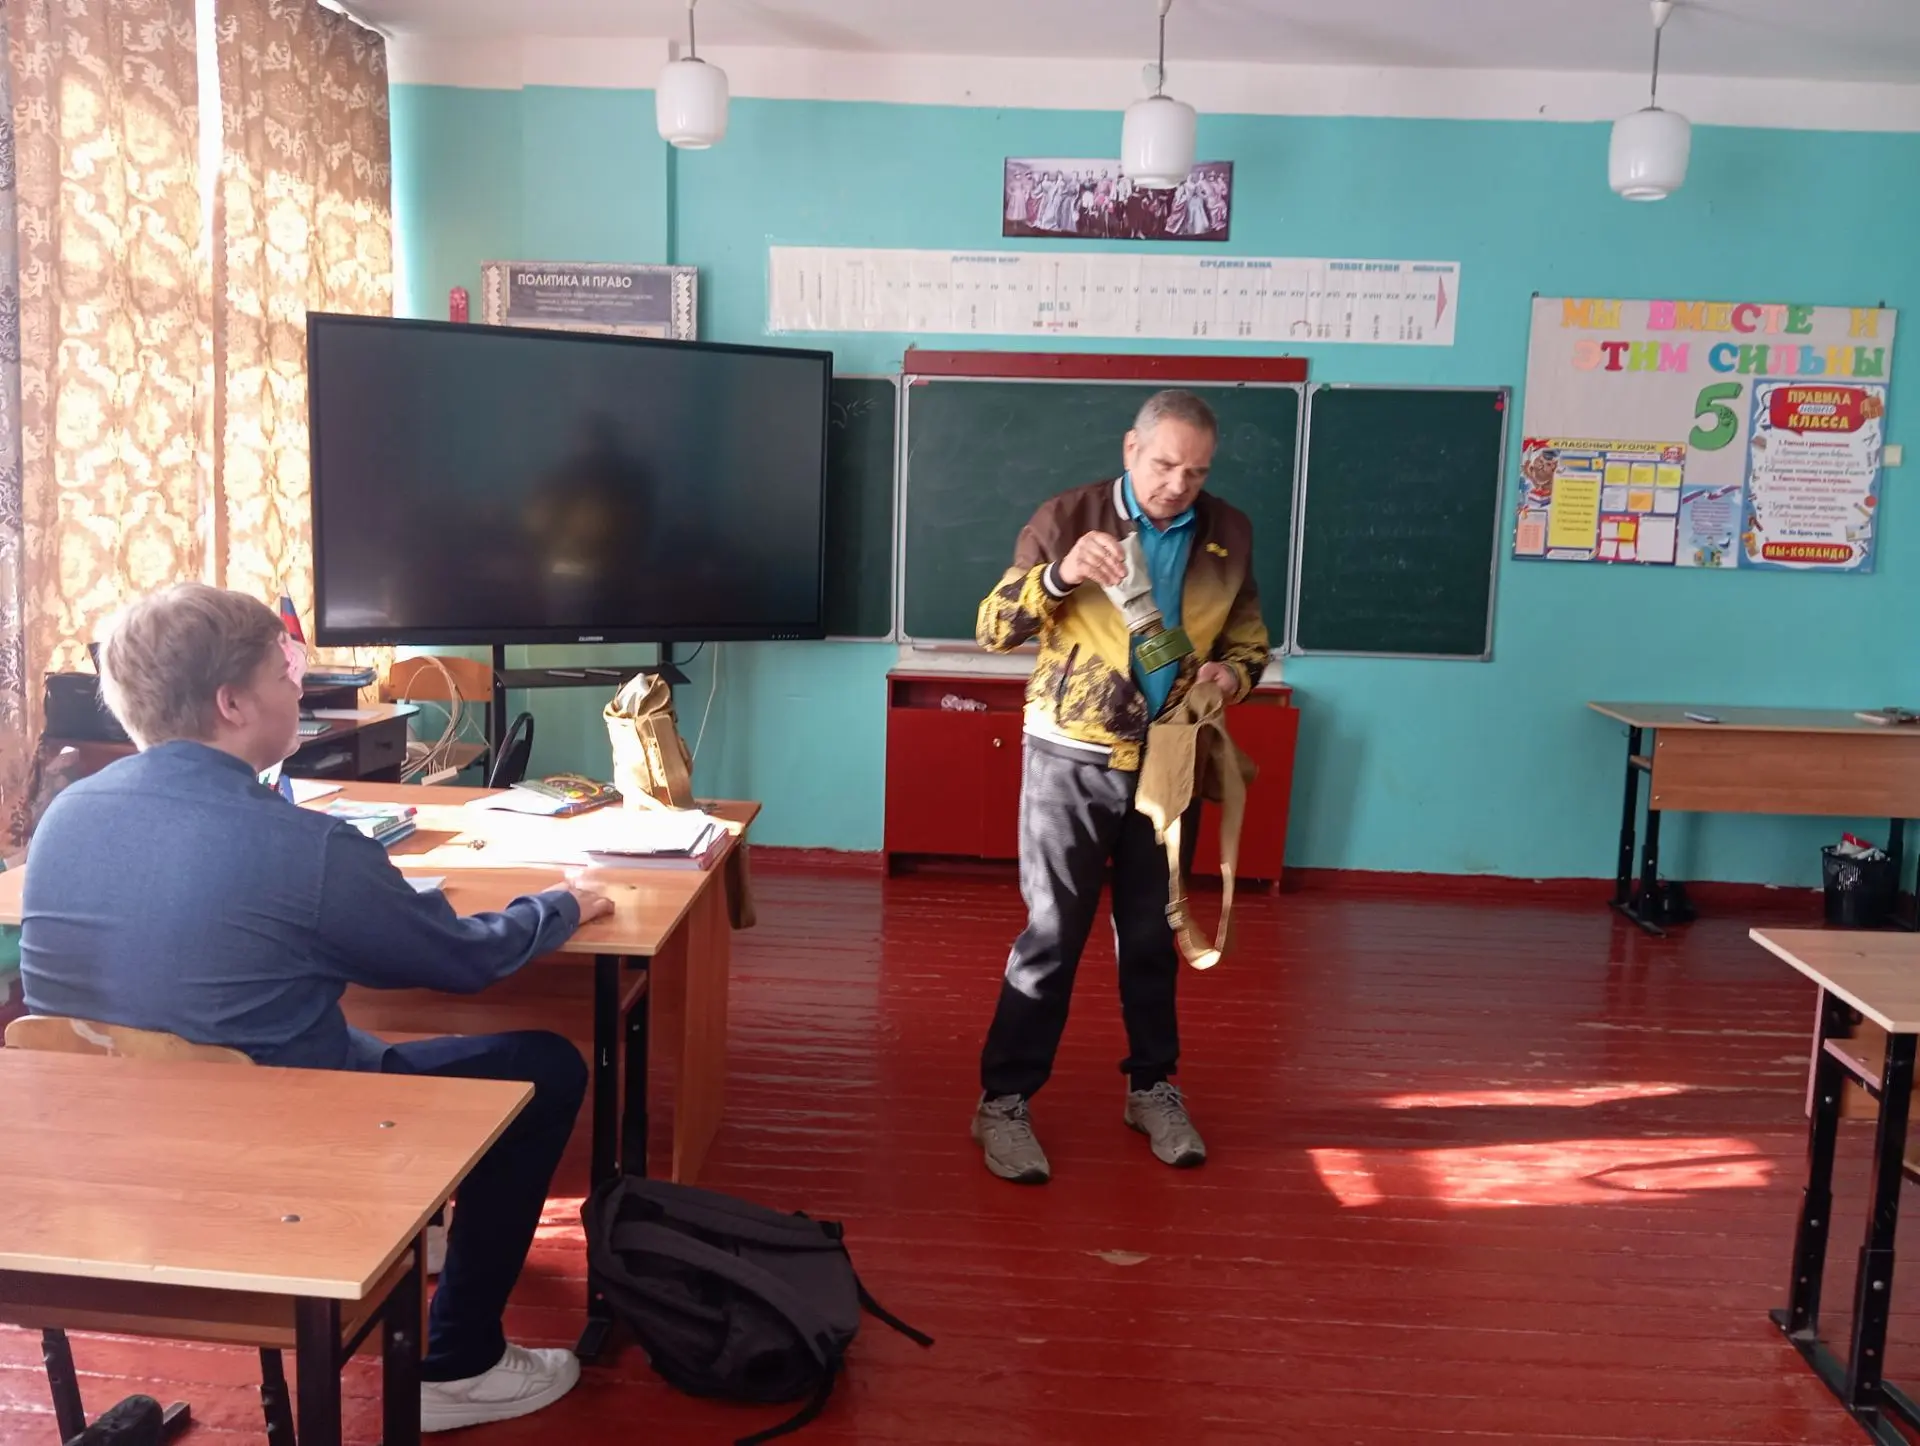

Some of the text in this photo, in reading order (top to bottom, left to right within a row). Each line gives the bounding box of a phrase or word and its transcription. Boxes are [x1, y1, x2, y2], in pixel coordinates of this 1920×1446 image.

[518, 274, 632, 288] ПОЛИТИКА И ПРАВО
[1560, 297, 1881, 338] МЫ ВМЕСТЕ И
[1570, 340, 1886, 378] ЭТИМ СИЛЬНЫ
[1787, 389, 1852, 406] ПРАВИЛА
[1688, 382, 1744, 452] 5
[1788, 414, 1850, 430] КЛАССА
[1553, 440, 1658, 452] КЛАССНЫЙ УГОЛОК
